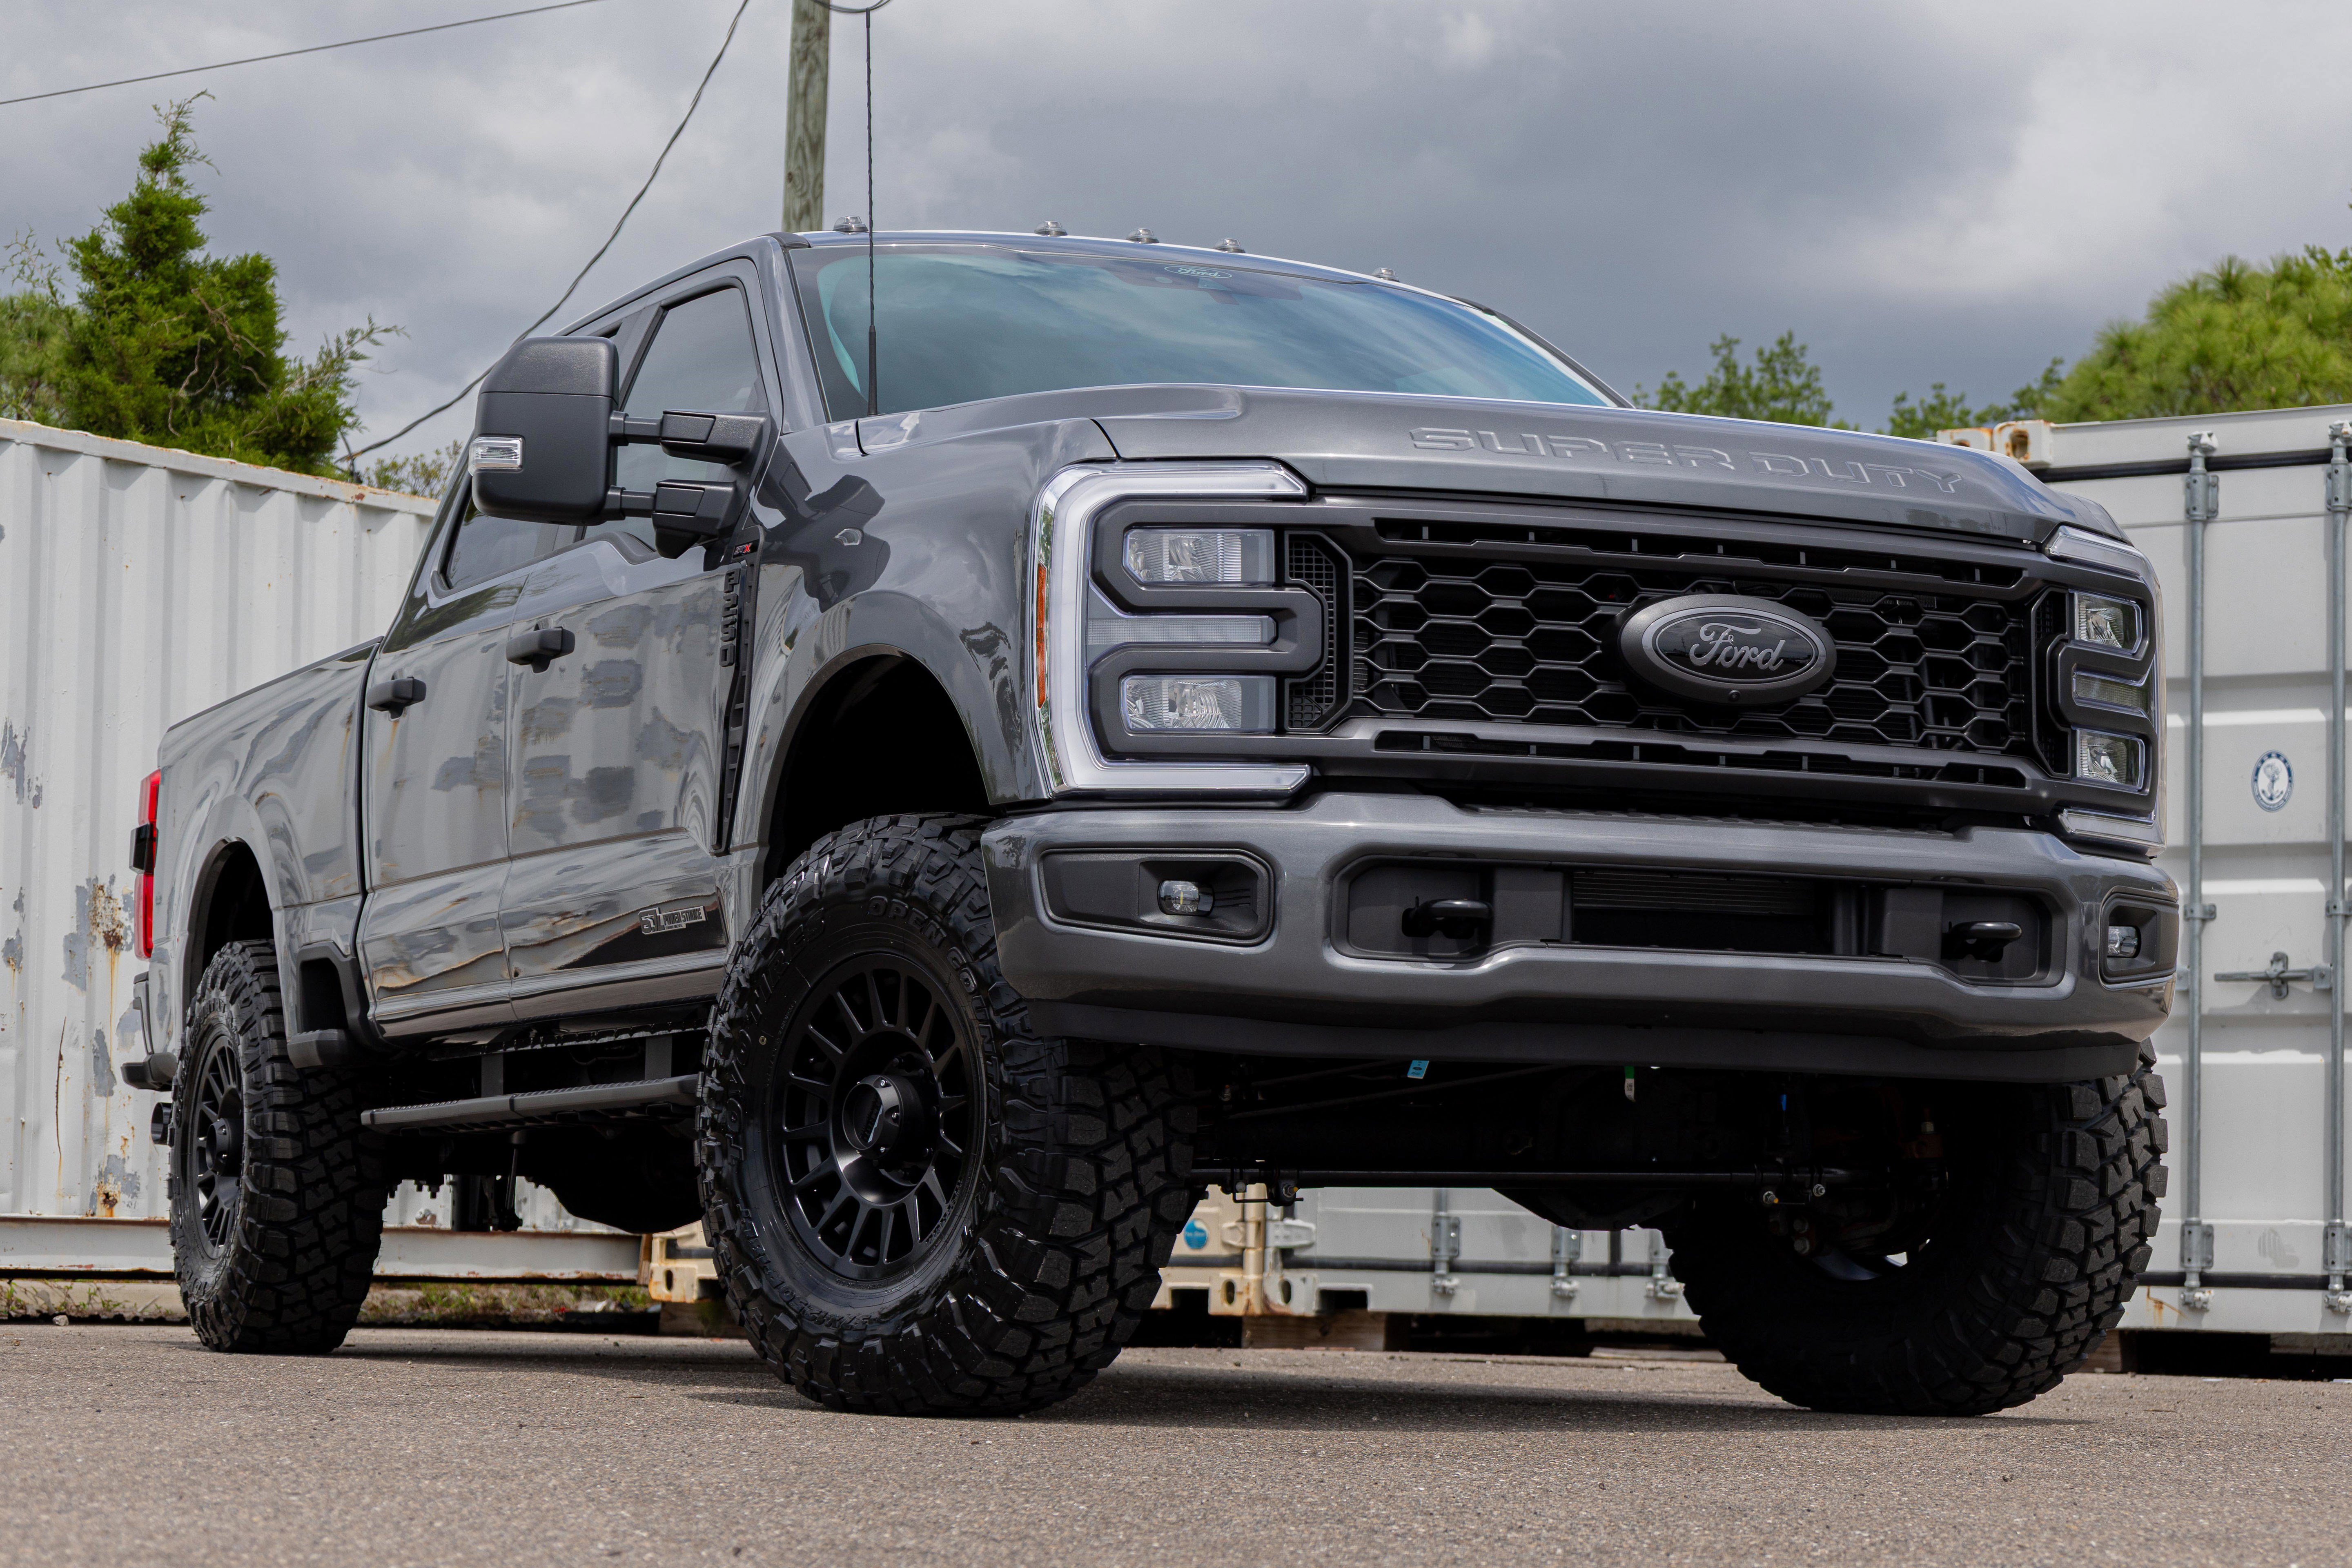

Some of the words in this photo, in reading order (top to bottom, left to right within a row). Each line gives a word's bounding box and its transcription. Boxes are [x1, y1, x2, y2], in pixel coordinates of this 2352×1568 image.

[1178, 267, 1221, 277] Ford
[1409, 427, 1736, 471] SUPER
[1750, 450, 1962, 494] DUTY
[734, 543, 753, 555] STX
[1689, 622, 1786, 671] Ford
[663, 912, 682, 925] POWER
[681, 908, 703, 922] STROKE
[869, 895, 947, 948] OPEN
[744, 907, 825, 1026] TIRES
